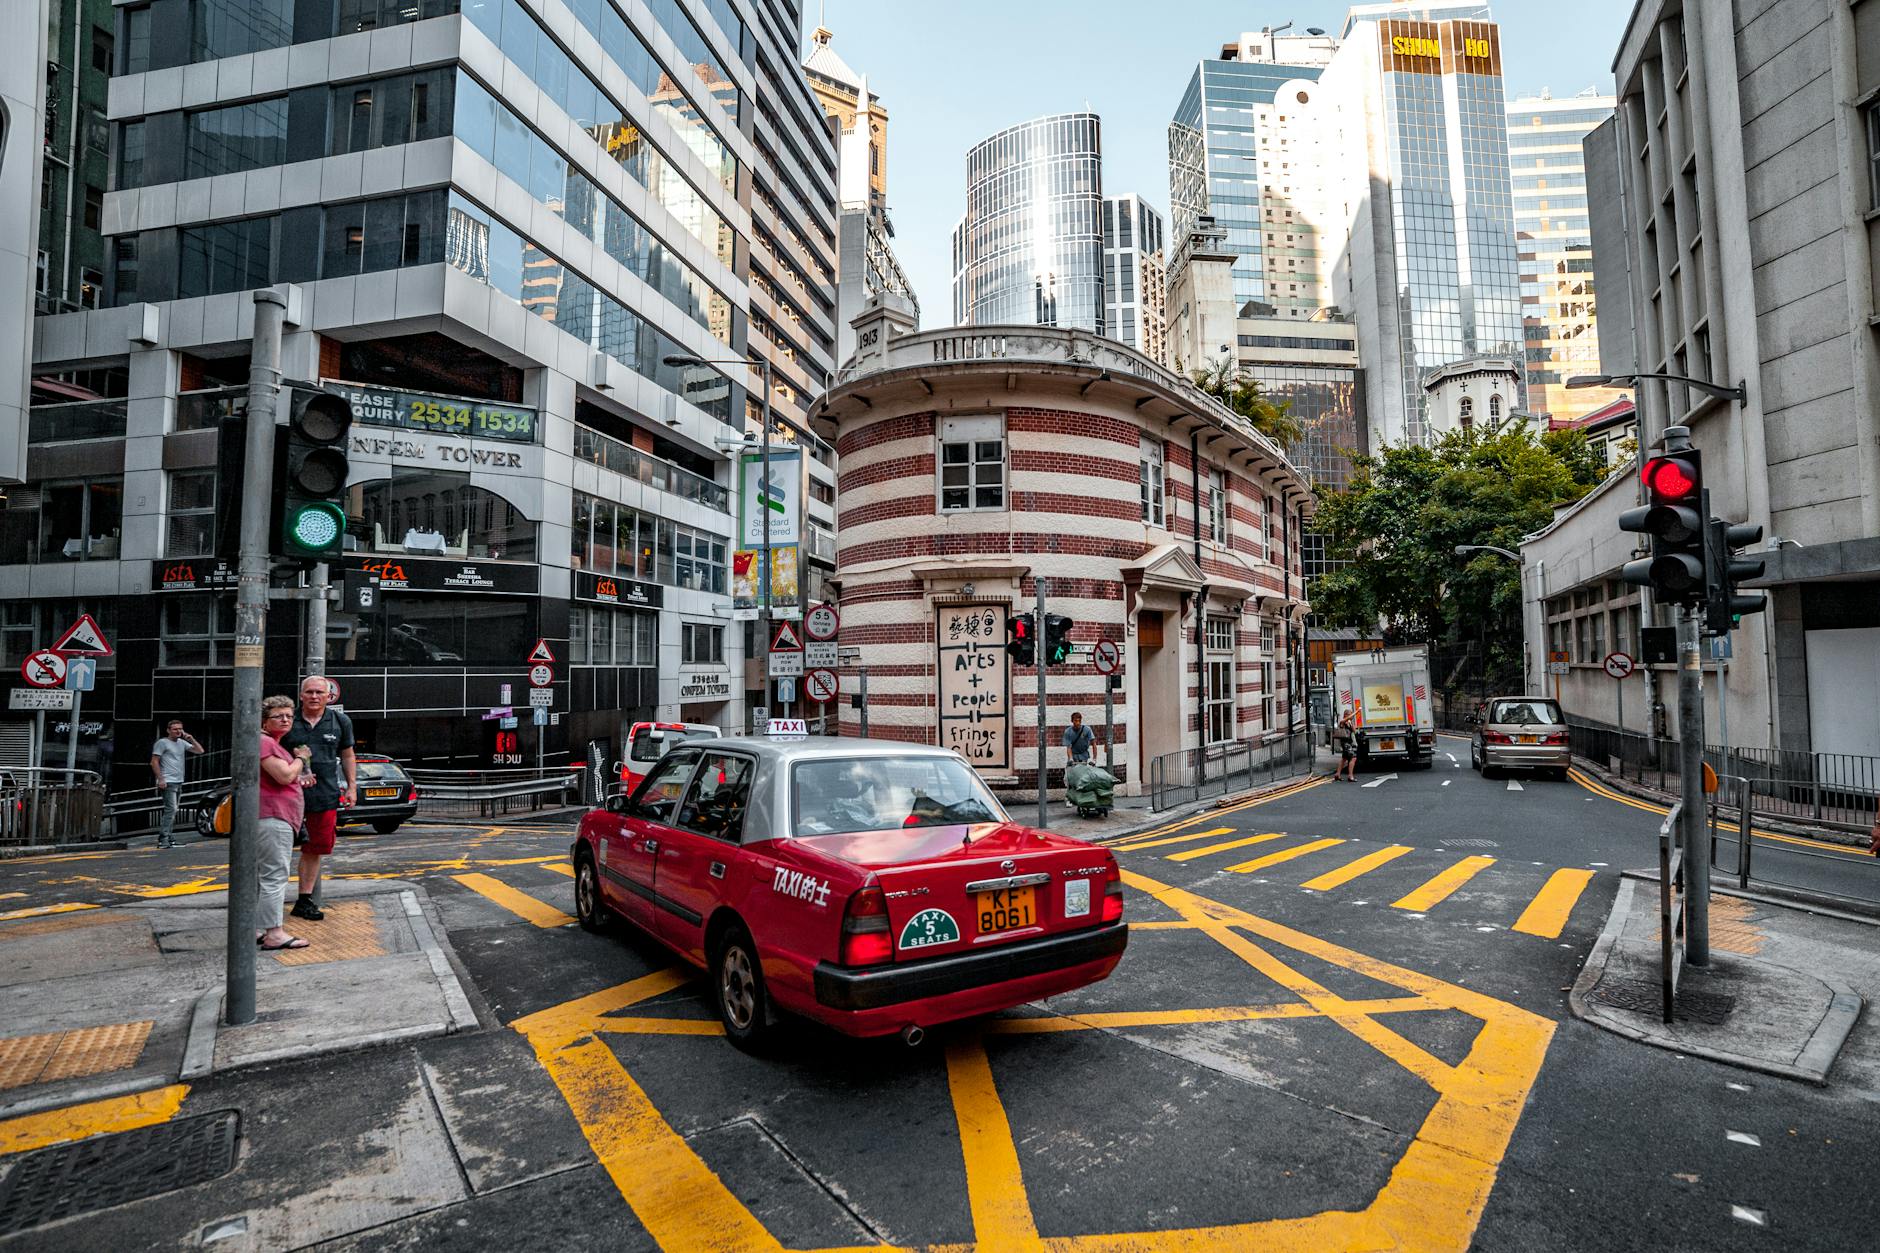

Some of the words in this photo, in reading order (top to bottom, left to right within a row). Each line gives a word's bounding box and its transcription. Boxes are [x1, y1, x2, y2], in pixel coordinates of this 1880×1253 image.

[1393, 36, 1440, 58] SHUN
[1465, 37, 1489, 58] HO
[860, 328, 878, 349] 1913
[352, 405, 404, 421] QUIRY
[410, 401, 471, 427] 2534
[477, 411, 530, 433] 1534
[353, 437, 425, 459] NFEM
[438, 445, 522, 468] TOWER
[815, 611, 830, 620] 5.5
[955, 653, 995, 671] Arts
[707, 684, 729, 695] TOWER
[774, 720, 804, 731] TAXI
[992, 889, 1019, 909] KF
[911, 911, 946, 928] TAXI
[981, 905, 1029, 931] 8061
[925, 920, 935, 935] 5
[910, 933, 950, 946] SEATS
